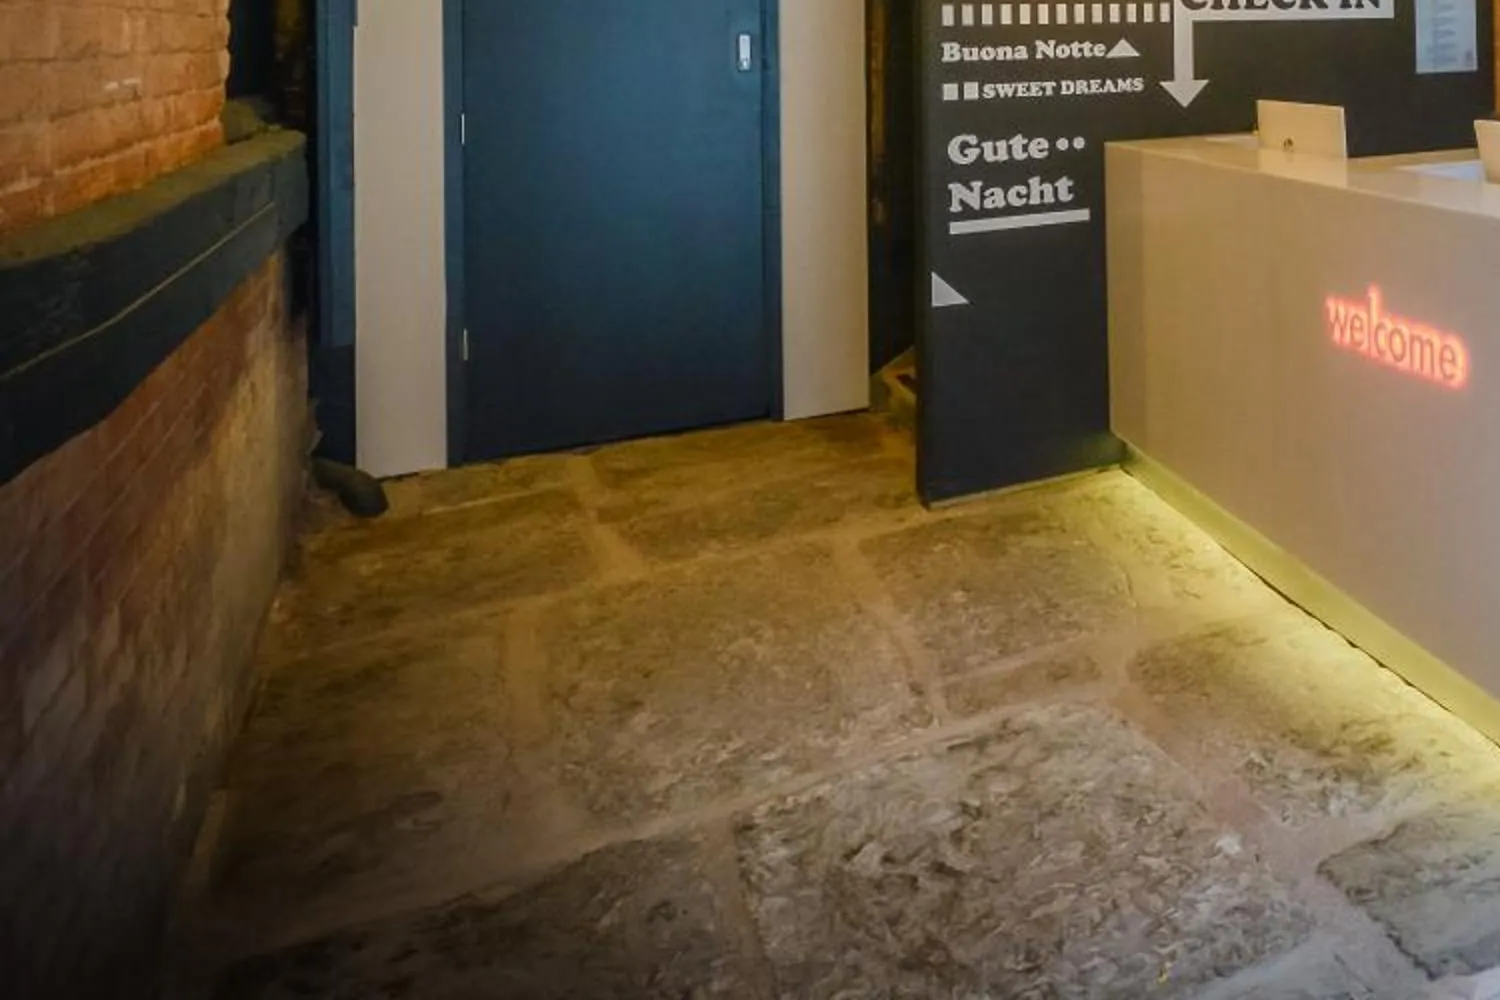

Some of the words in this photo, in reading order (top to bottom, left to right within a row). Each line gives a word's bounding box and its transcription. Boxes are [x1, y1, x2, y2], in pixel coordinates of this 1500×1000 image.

[941, 42, 1029, 63] Buona
[1035, 39, 1107, 60] Notte
[982, 81, 1056, 99] SWEET
[1060, 77, 1145, 96] DREAMS
[948, 175, 1075, 213] Nacht
[1326, 289, 1461, 382] welcome
